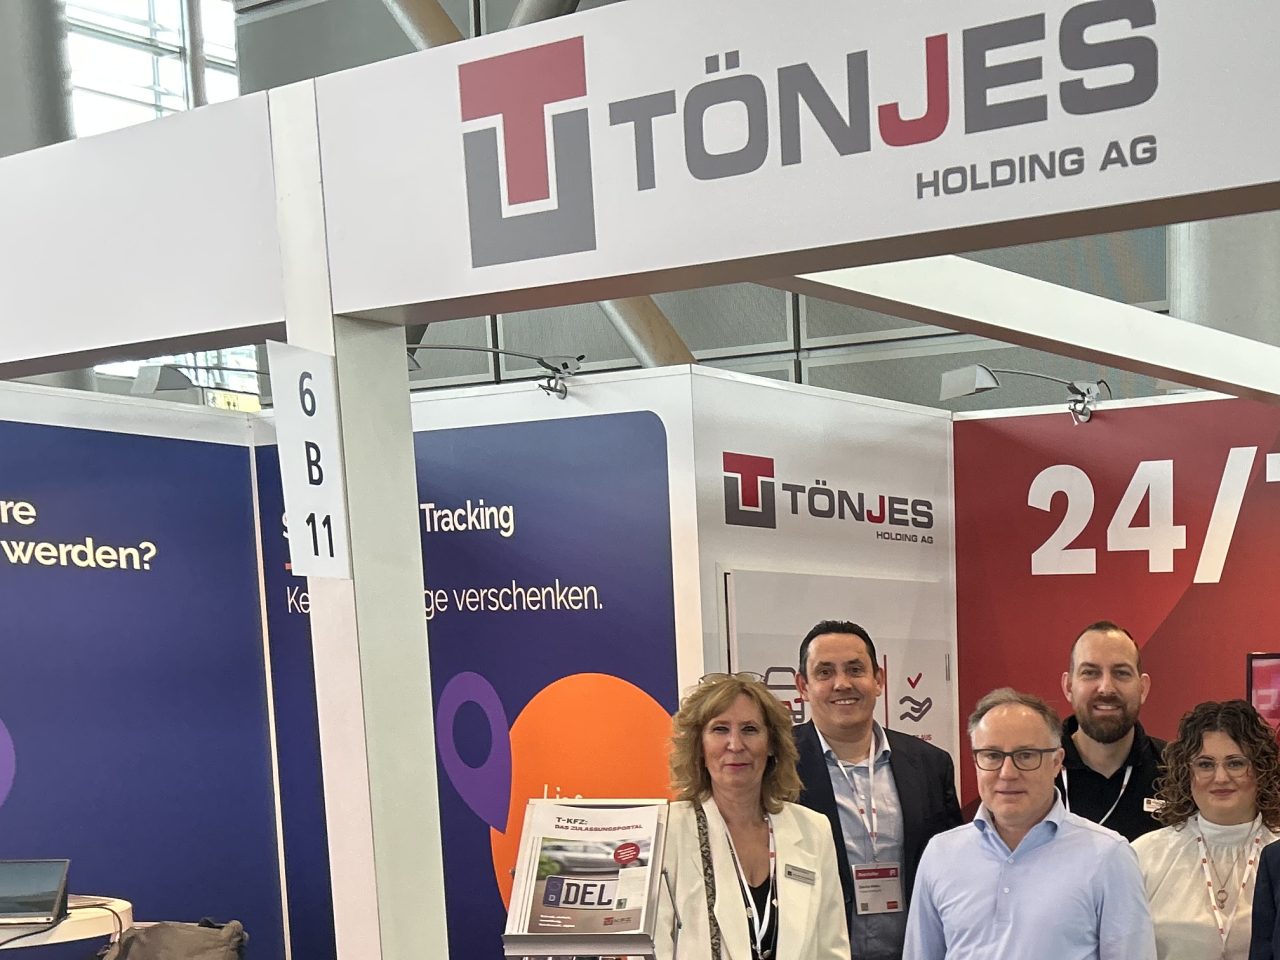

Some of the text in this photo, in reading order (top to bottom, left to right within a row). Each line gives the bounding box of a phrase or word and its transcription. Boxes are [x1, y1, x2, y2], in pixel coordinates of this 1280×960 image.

[608, 0, 1159, 192] TÖNJES
[916, 135, 1159, 199] HOLDING AG
[298, 371, 317, 418] 6
[305, 441, 325, 486] B
[782, 479, 934, 529] TÖNJES
[0, 536, 157, 571] werden?
[305, 512, 335, 558] 11
[877, 531, 934, 545] HOLDING AG
[452, 580, 604, 612] verschenken.
[562, 882, 613, 906] DEL
